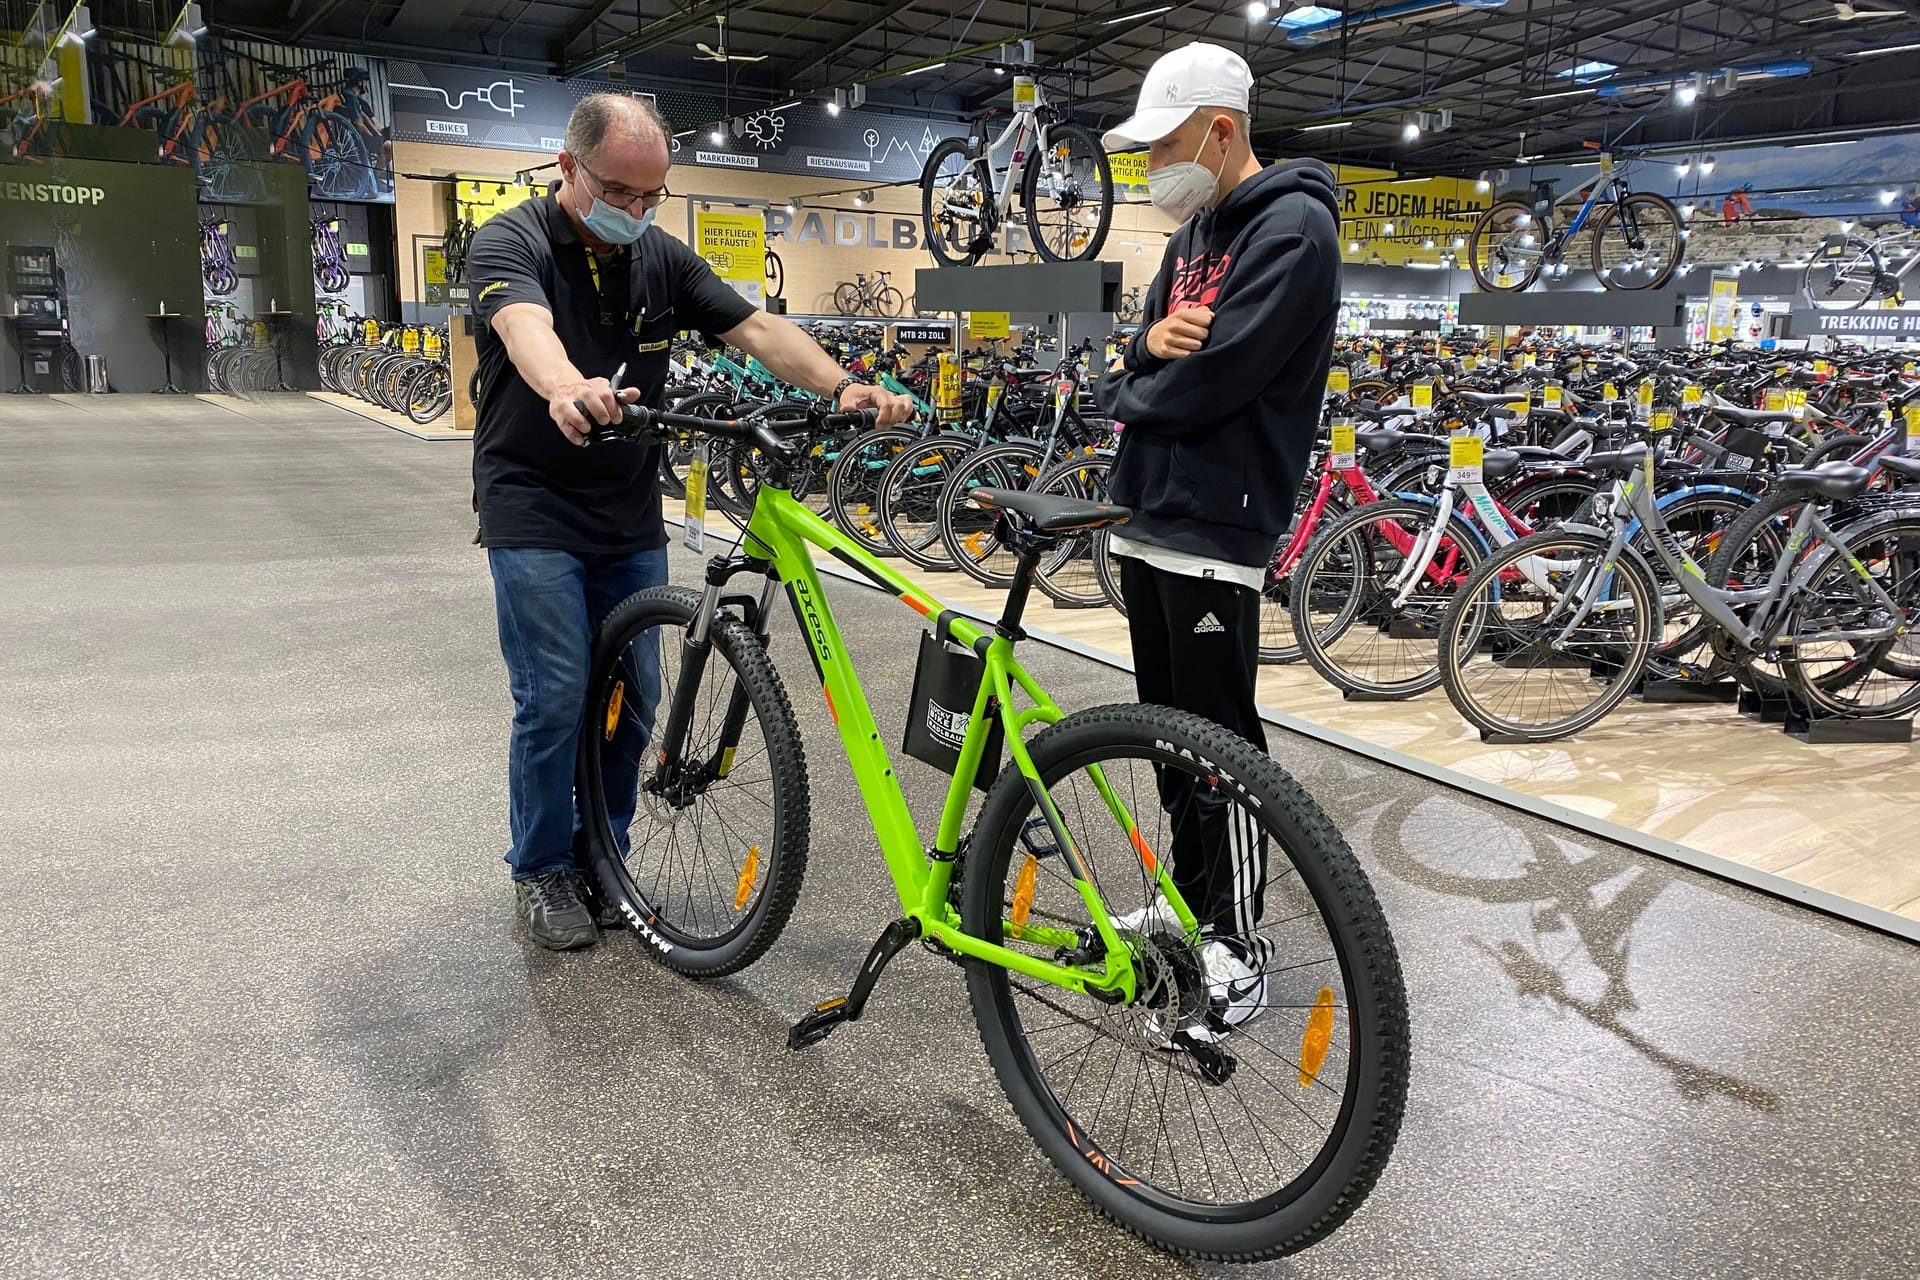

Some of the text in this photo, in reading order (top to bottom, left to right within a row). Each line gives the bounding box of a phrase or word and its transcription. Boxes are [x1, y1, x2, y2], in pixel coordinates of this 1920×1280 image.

[430, 122, 465, 133] E-BIKES
[810, 157, 867, 170] RIESENAUSWAHL
[1133, 159, 1147, 168] DAS
[1111, 168, 1134, 177] HTIGE
[1363, 191, 1427, 218] JEDEM
[1432, 197, 1481, 223] HELM
[704, 228, 757, 238] HIER FLIEGEN
[704, 238, 718, 246] DIE
[1820, 315, 1899, 330] TREKKING
[900, 331, 946, 340] MTB 29 ZOLL
[1456, 471, 1471, 479] 349
[1193, 625, 1225, 633] adidas
[930, 703, 951, 720] LUCKY
[929, 709, 950, 728] BIKE
